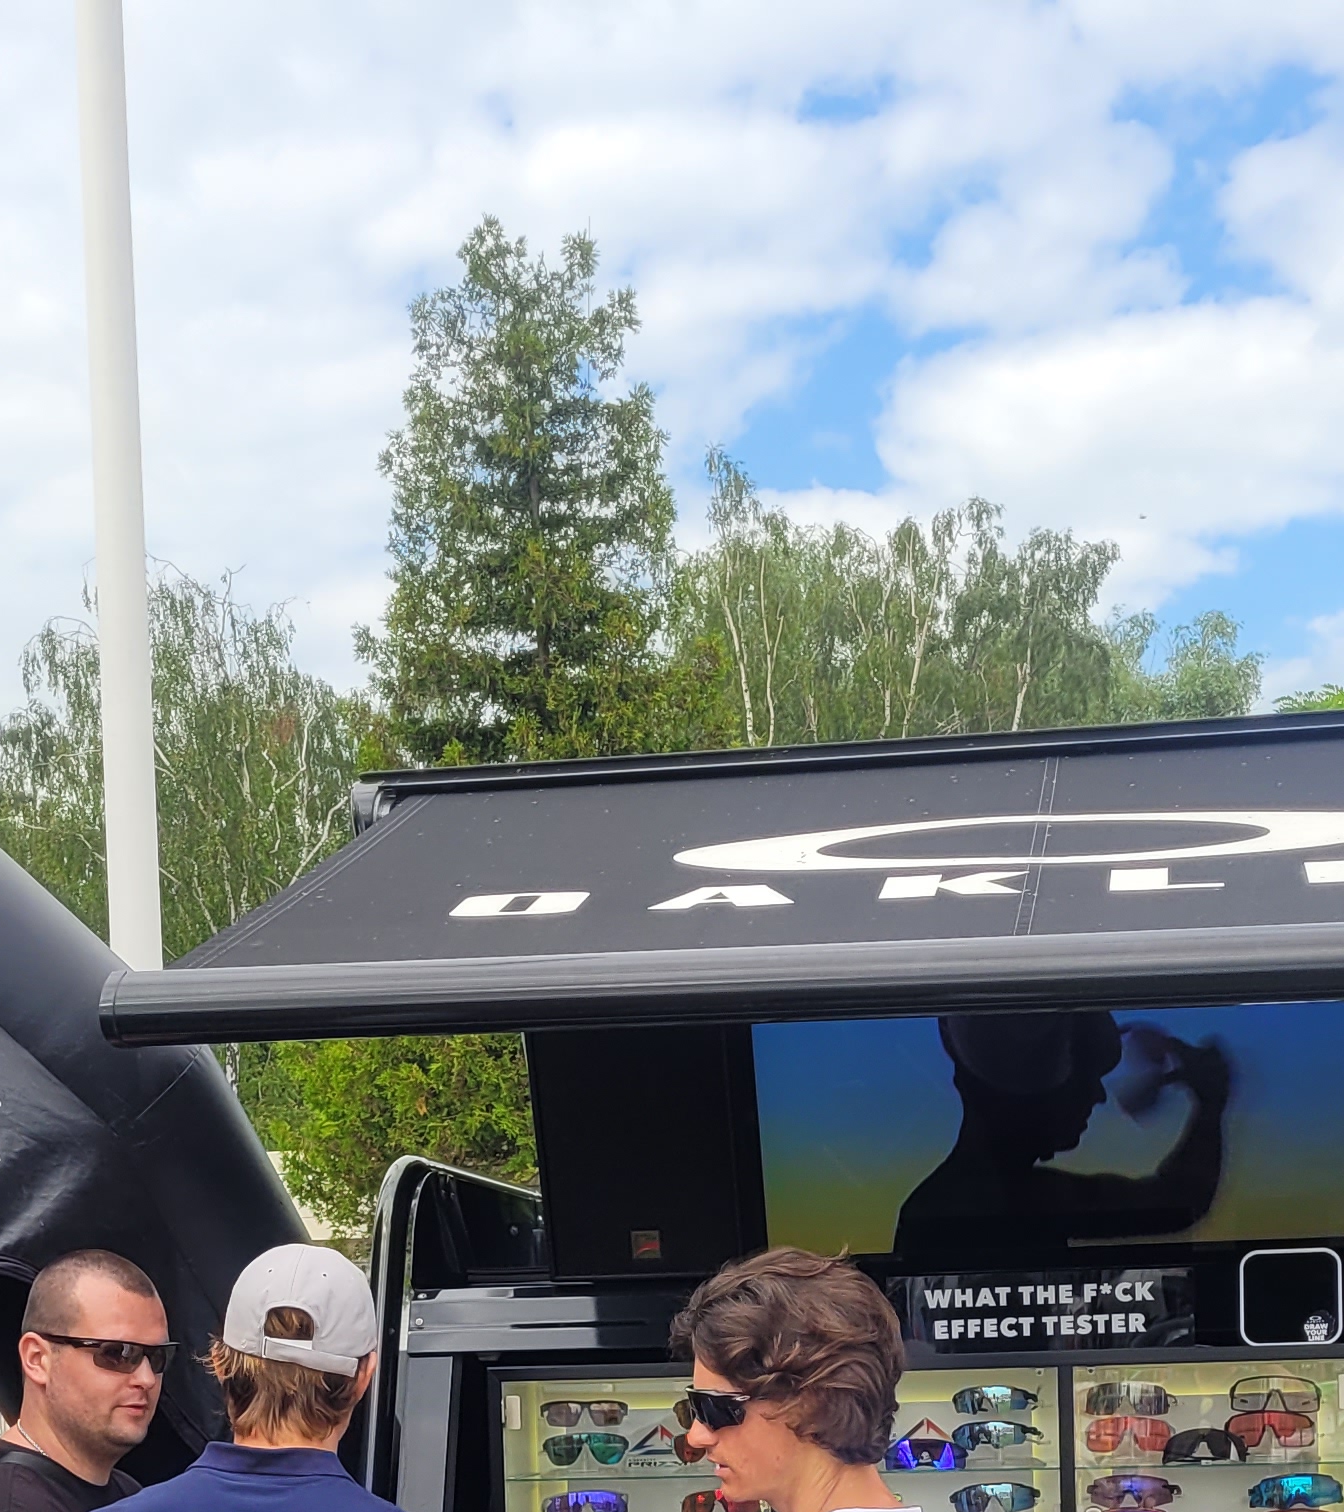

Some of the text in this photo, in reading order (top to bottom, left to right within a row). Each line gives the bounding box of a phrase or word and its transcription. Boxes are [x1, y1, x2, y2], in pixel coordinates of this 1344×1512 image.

[923, 1286, 1009, 1309] WHAT
[1017, 1283, 1075, 1307] THE
[933, 1312, 1148, 1341] EFFECT TESTER
